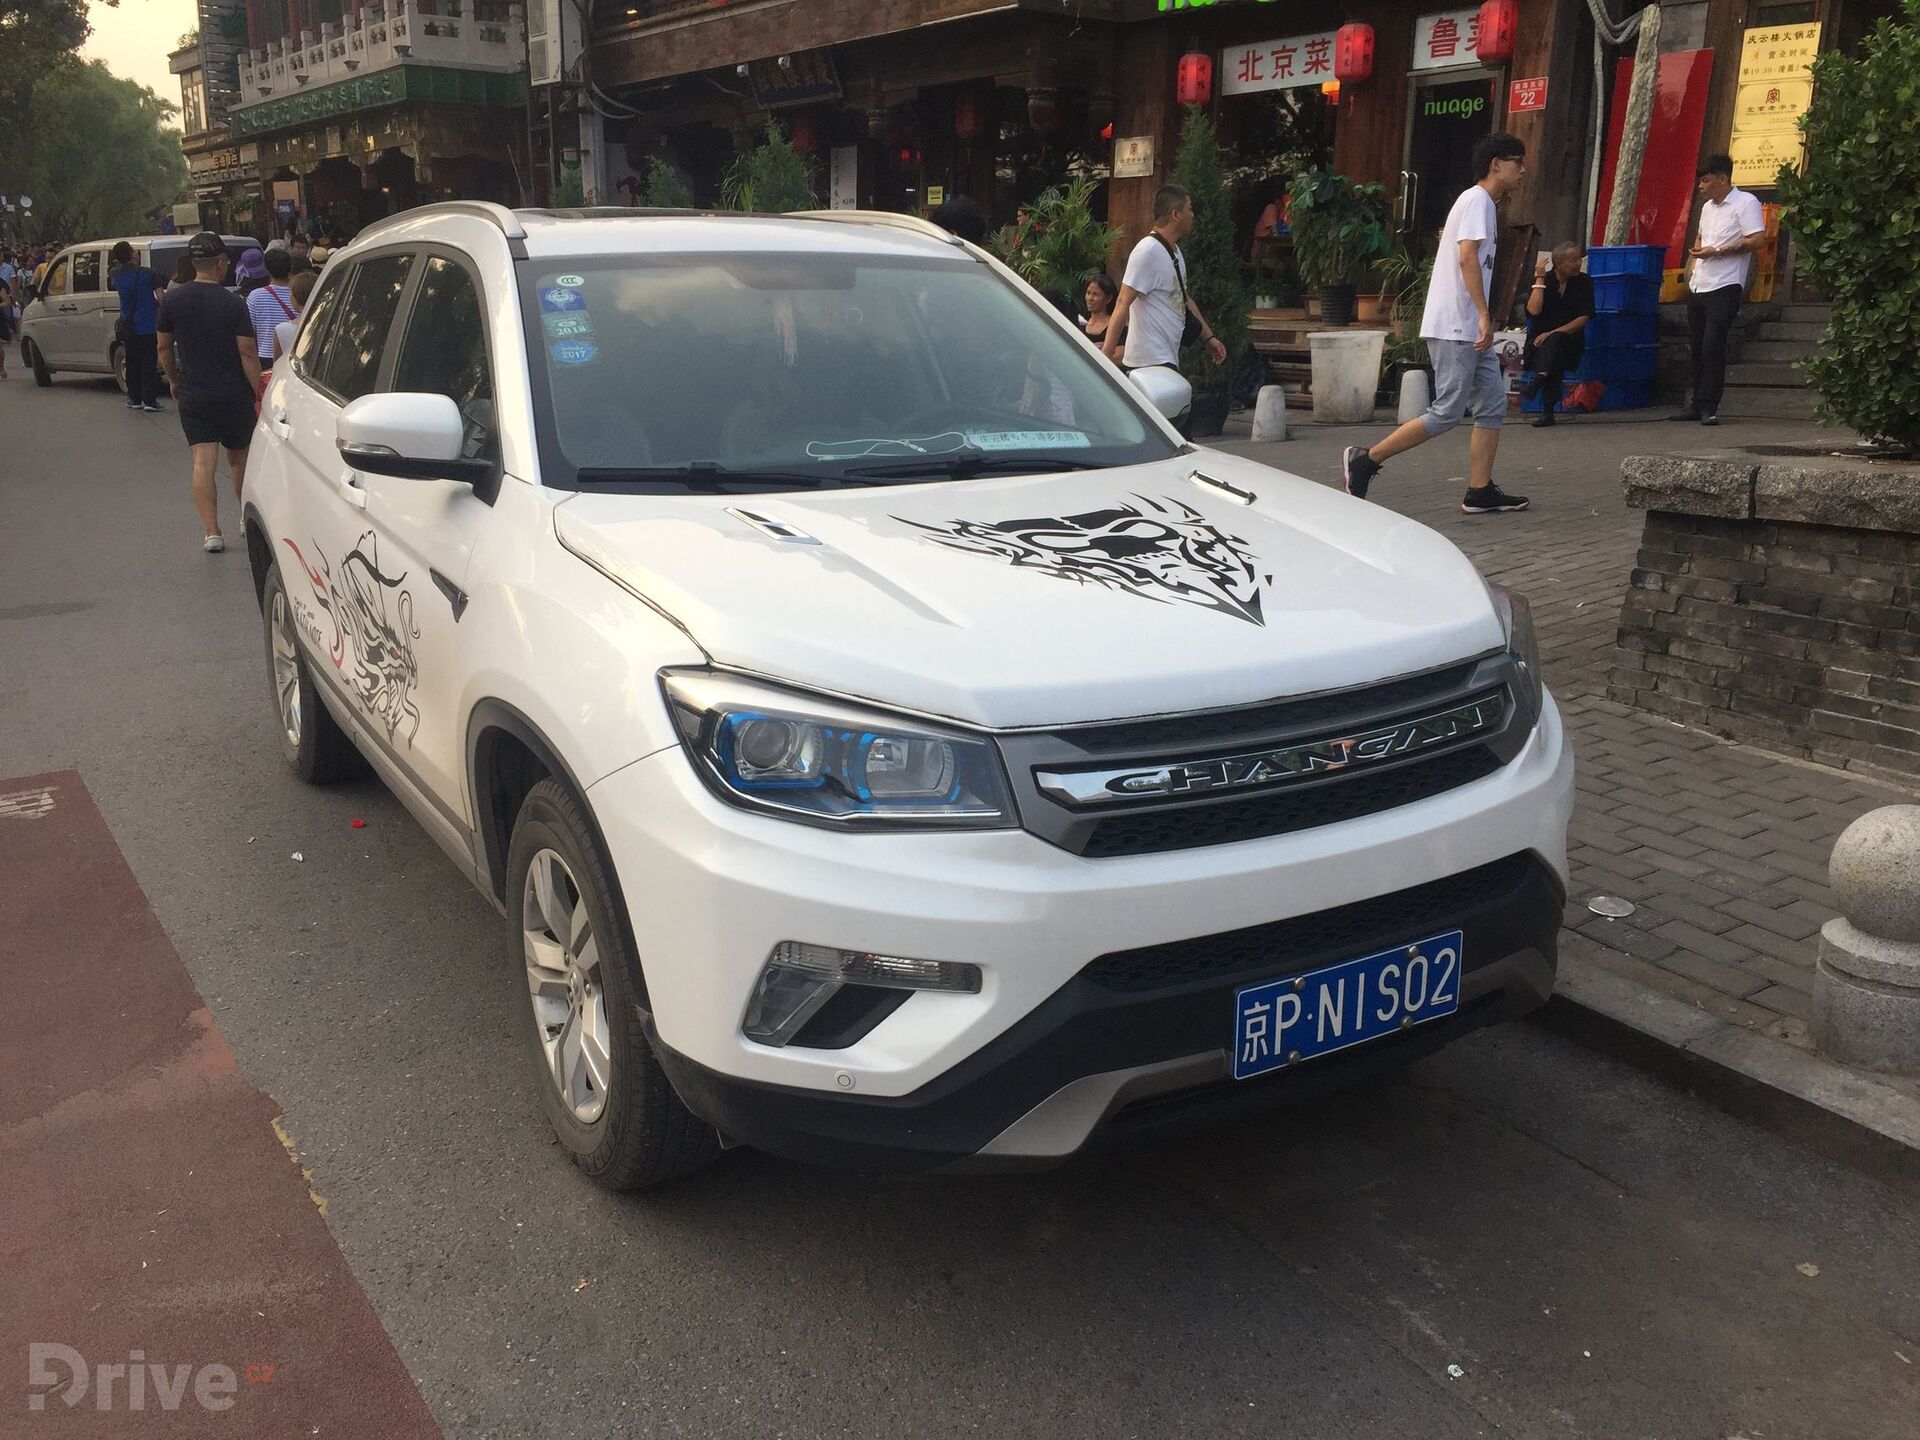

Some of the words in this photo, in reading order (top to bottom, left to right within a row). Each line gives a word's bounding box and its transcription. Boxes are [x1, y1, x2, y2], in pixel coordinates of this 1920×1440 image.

[1747, 29, 1816, 44] 庆云楼火锅店
[1238, 38, 1332, 82] 北京菜
[1424, 97, 1484, 119] nuage
[1520, 92, 1536, 106] 22
[562, 350, 586, 359] 2017
[1104, 705, 1484, 798] CHANGAN
